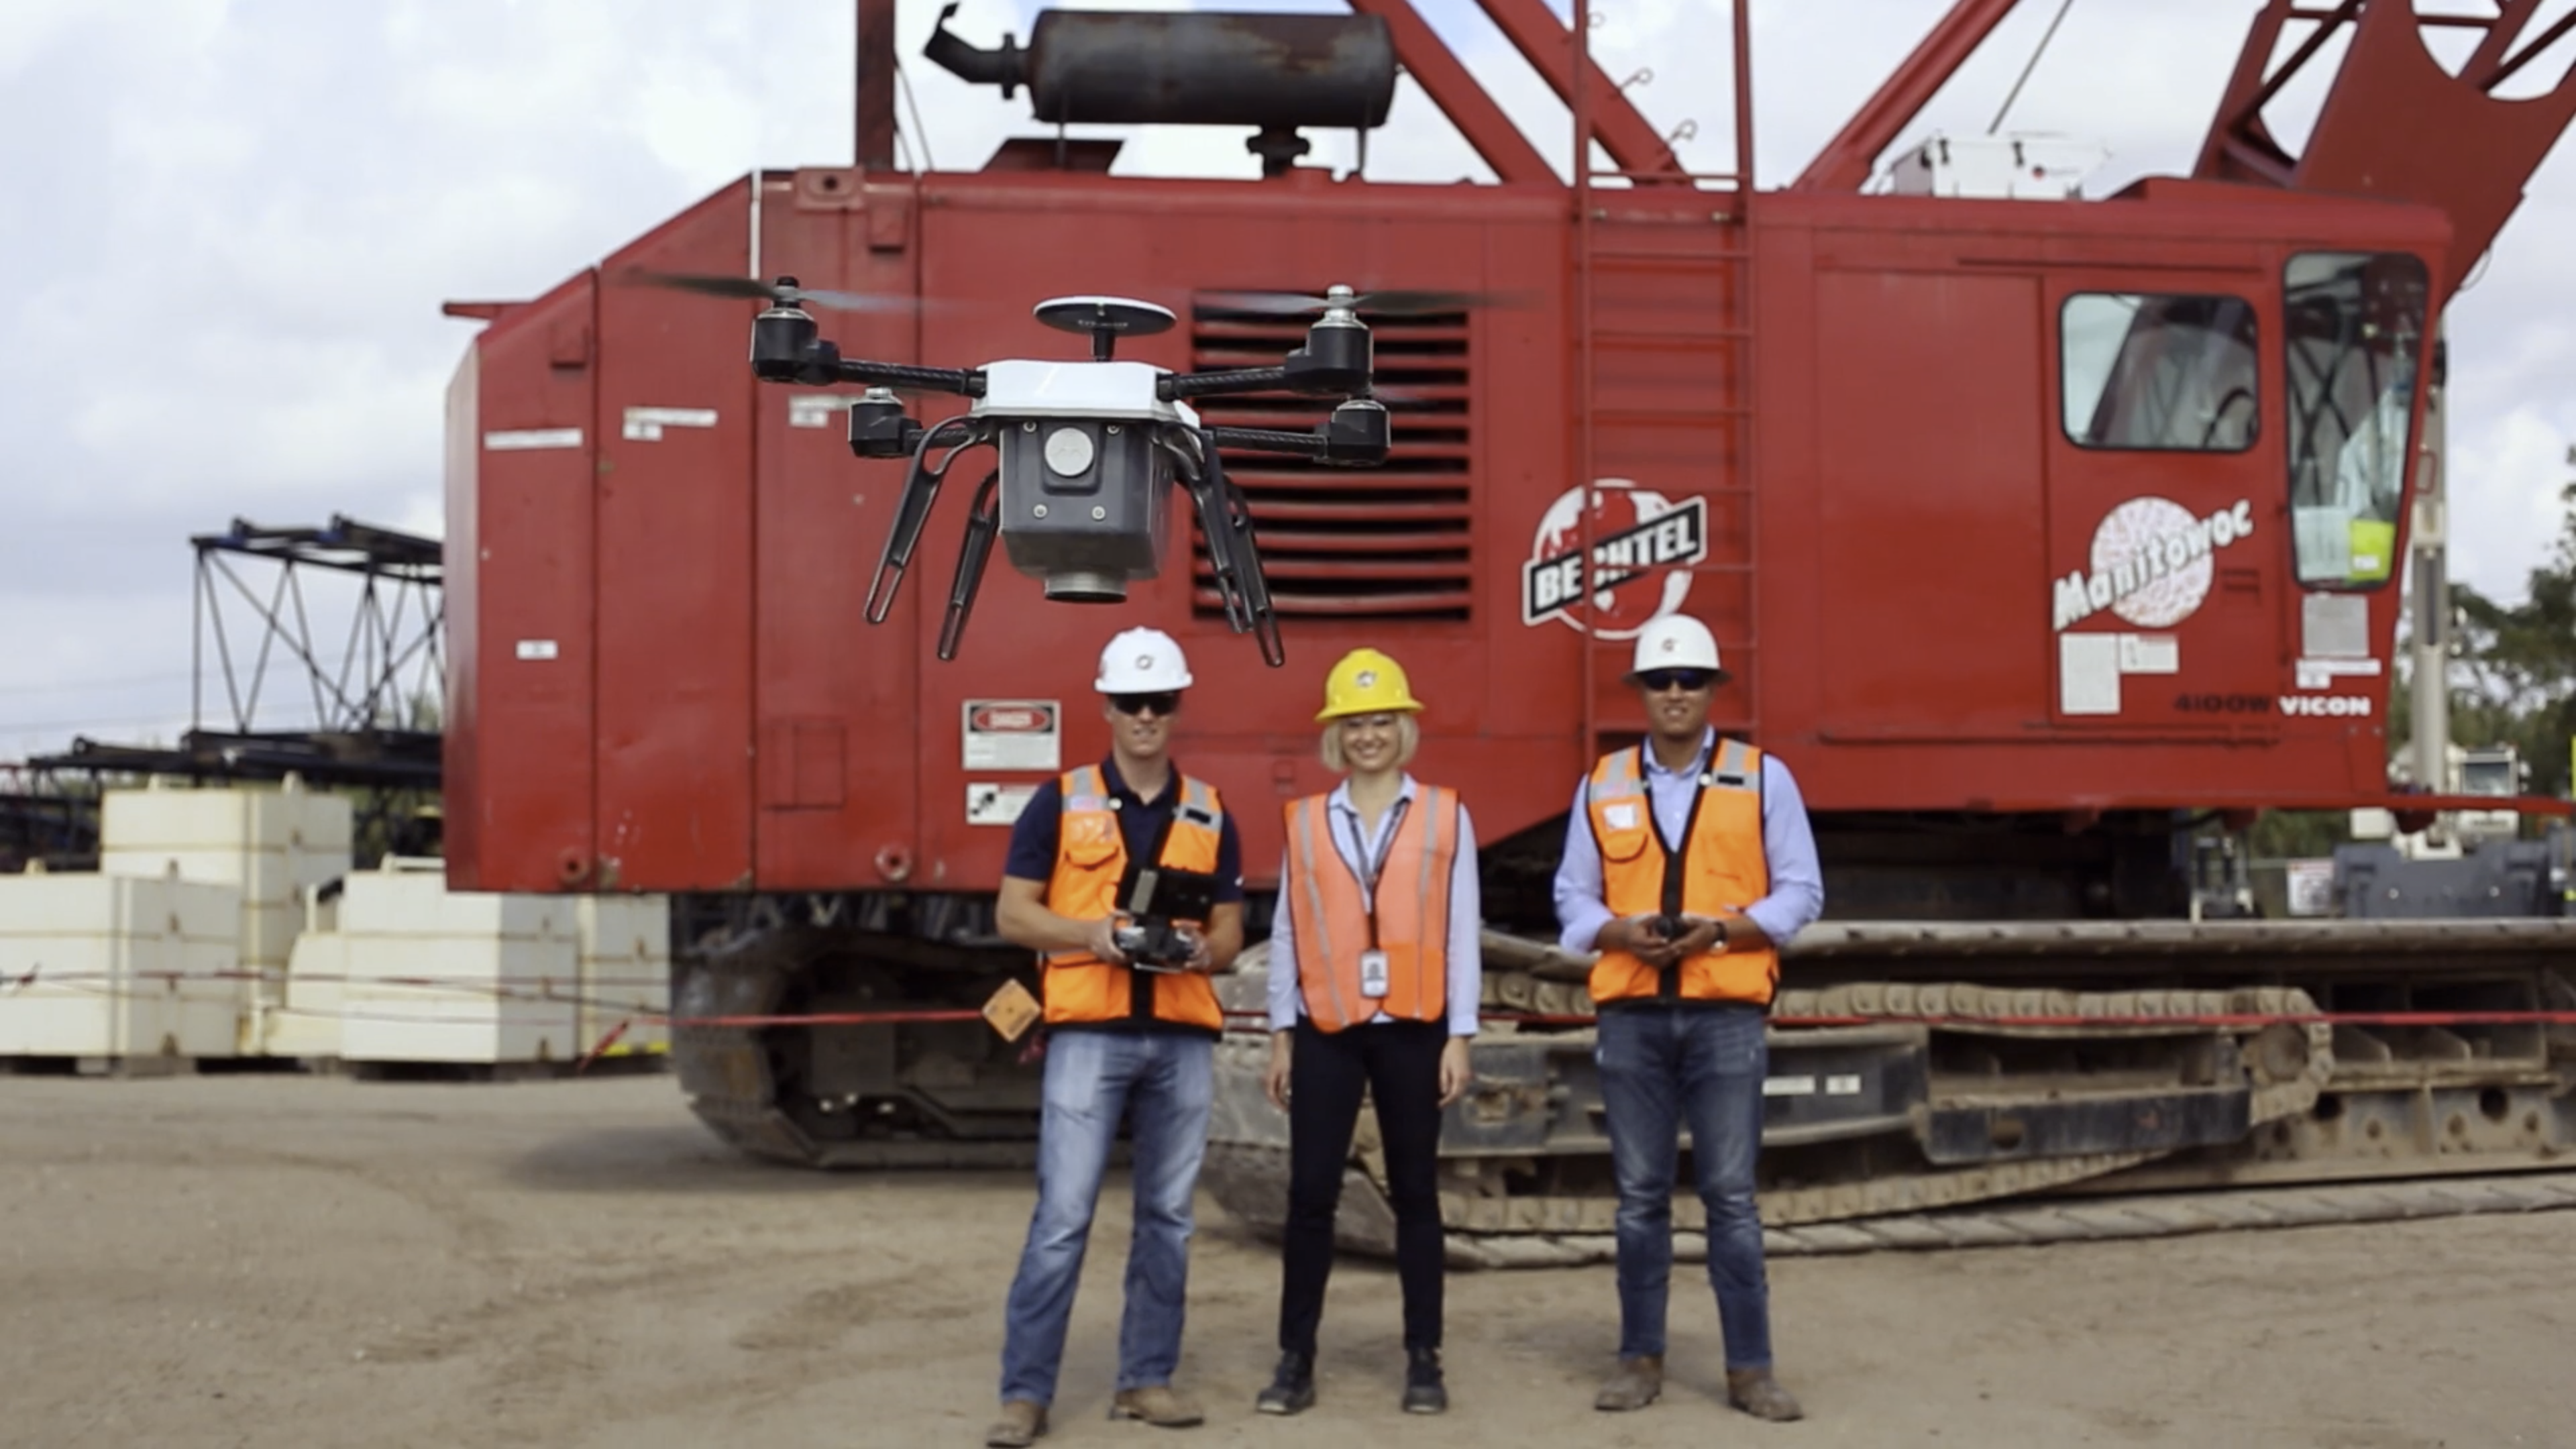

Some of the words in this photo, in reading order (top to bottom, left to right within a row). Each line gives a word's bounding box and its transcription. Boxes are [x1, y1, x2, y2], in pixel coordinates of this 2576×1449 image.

[2053, 498, 2253, 632] Manitowoc
[2174, 694, 2270, 713] 4100W
[2279, 695, 2372, 716] VICON
